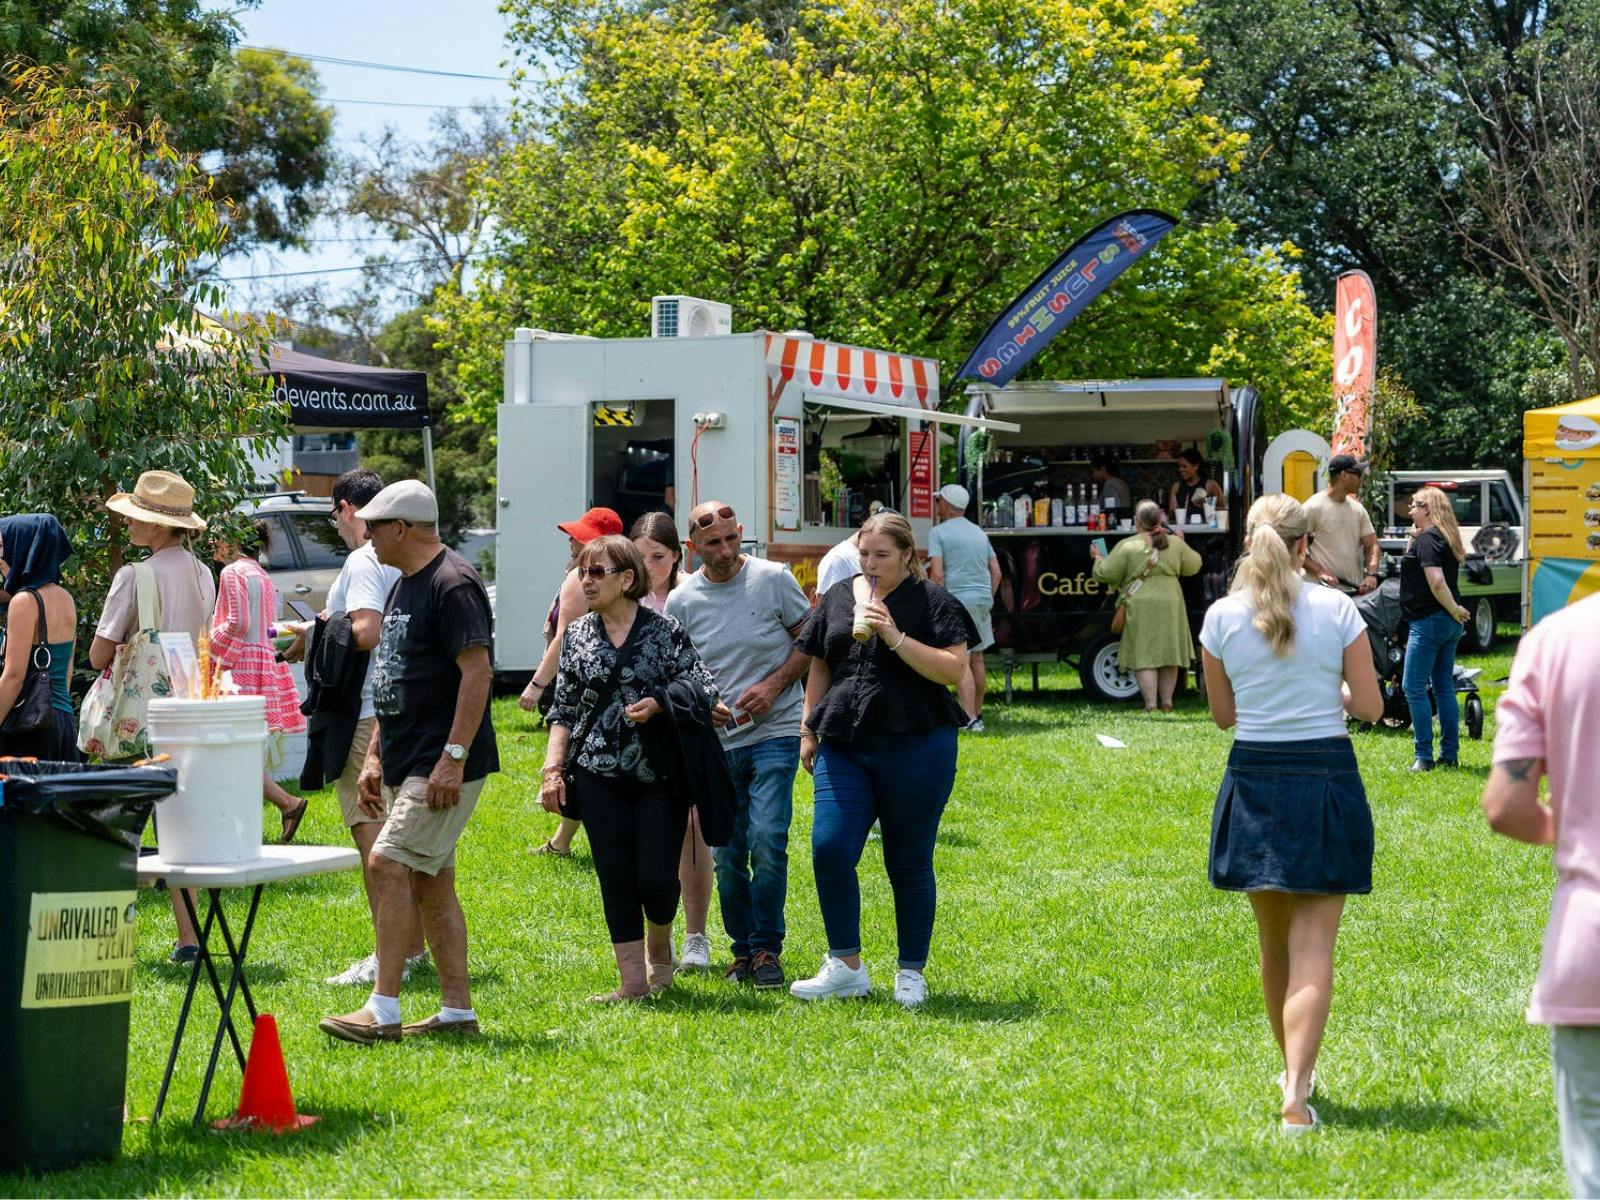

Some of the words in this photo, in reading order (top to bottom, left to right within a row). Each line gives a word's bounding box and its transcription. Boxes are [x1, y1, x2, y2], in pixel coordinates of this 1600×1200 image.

[1050, 259, 1078, 287] JUICE
[978, 243, 1121, 378] SLUSHIES
[1038, 572, 1099, 596] Cafe
[37, 906, 118, 941] UNRIVALLED
